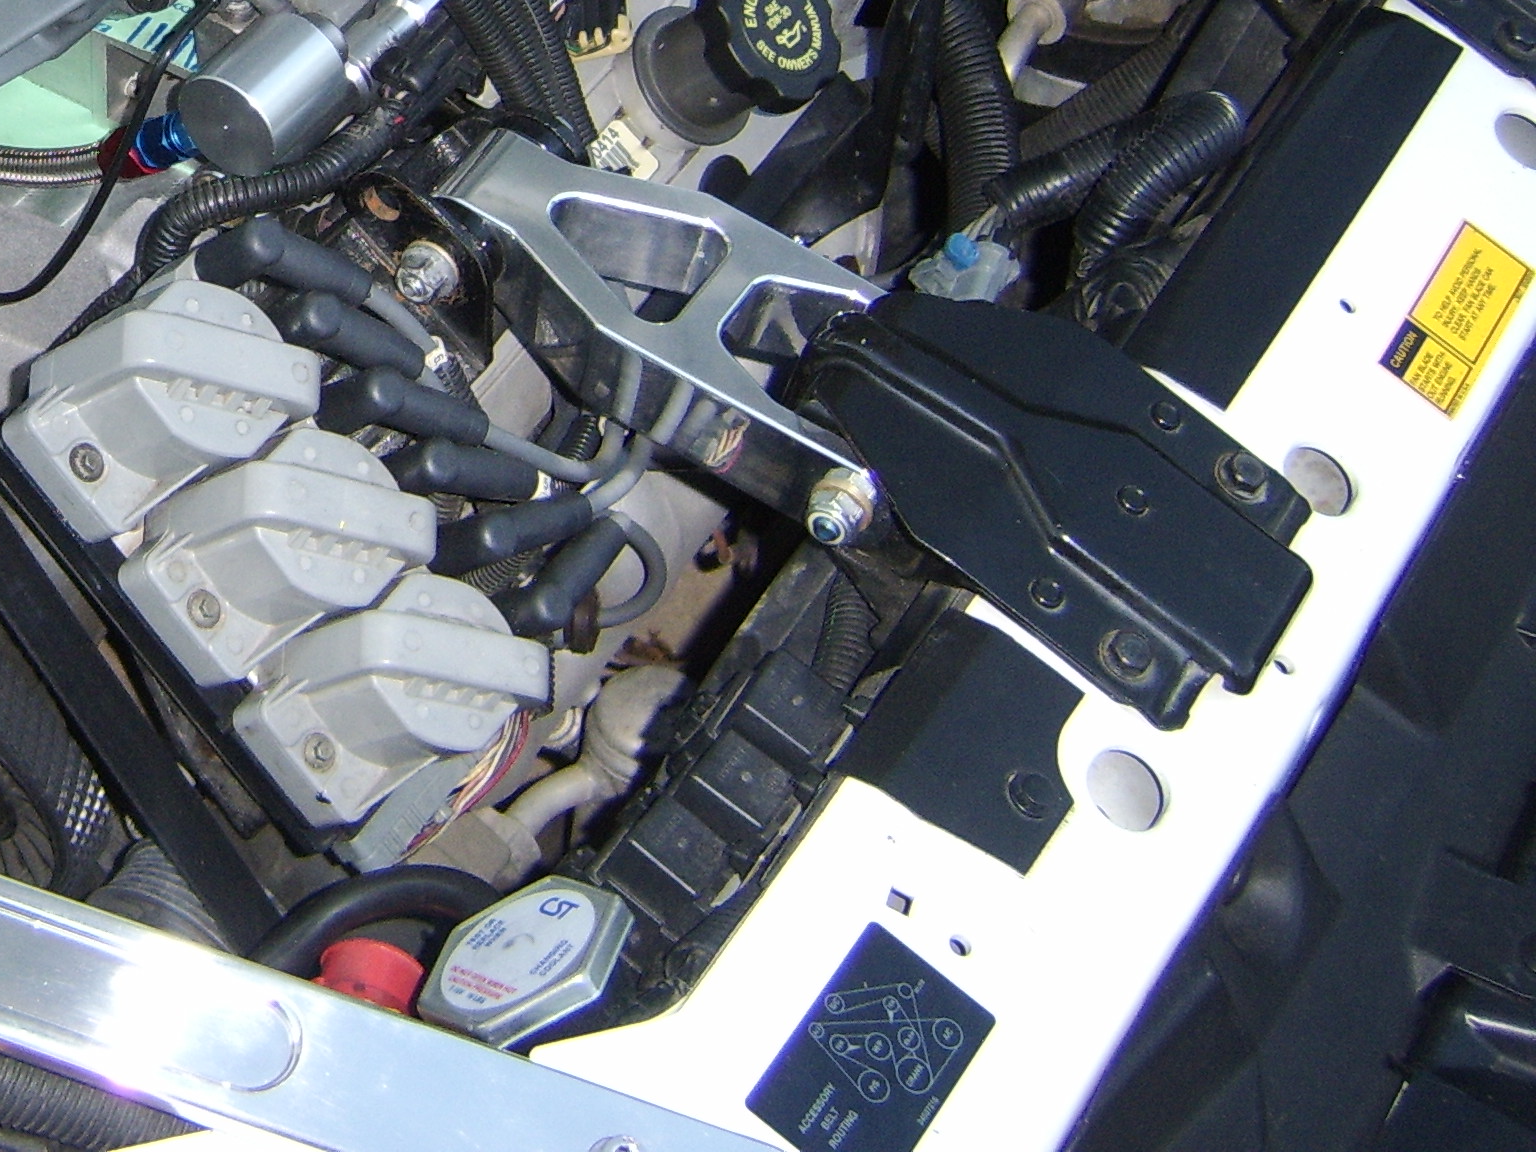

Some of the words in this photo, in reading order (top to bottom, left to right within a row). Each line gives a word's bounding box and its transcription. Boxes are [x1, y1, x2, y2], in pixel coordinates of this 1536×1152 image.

[756, 39, 777, 63] SEE
[591, 127, 620, 159] 0414
[1389, 330, 1419, 369] CAUTION
[539, 896, 581, 920] CST
[798, 1081, 835, 1135] ACCESSORY
[820, 1106, 840, 1131] BELT
[828, 1109, 859, 1150] ROUTING
